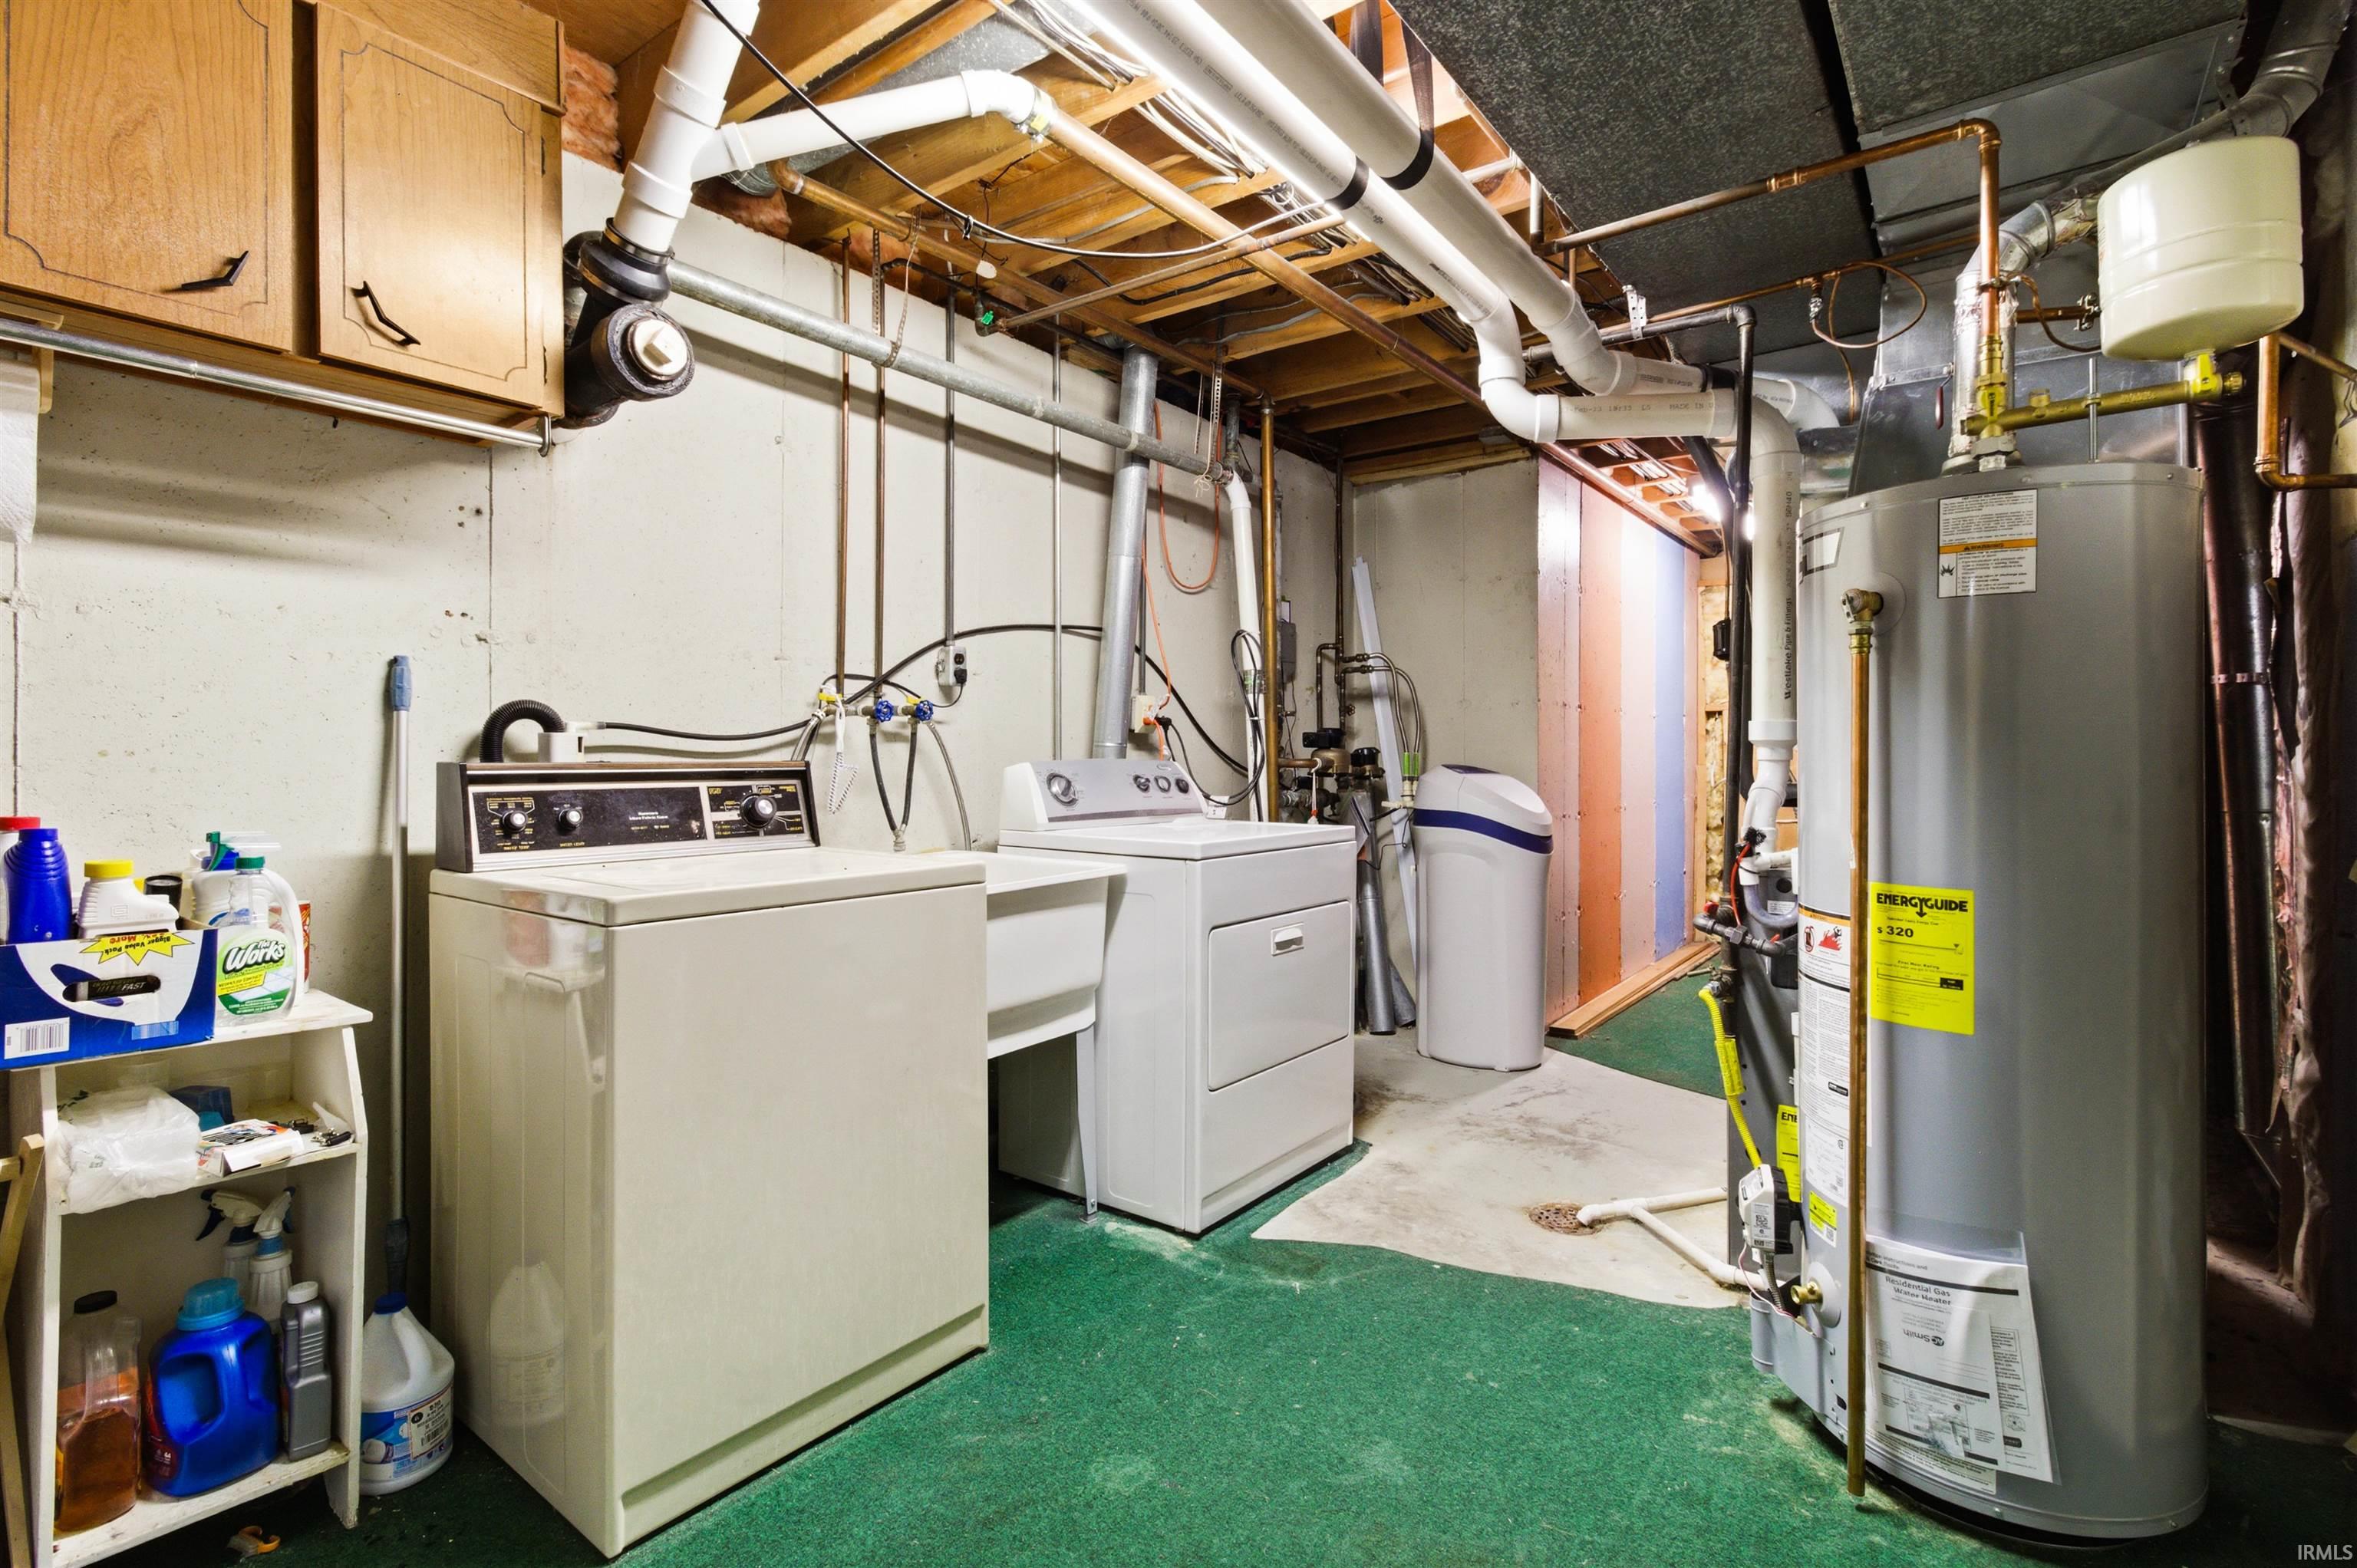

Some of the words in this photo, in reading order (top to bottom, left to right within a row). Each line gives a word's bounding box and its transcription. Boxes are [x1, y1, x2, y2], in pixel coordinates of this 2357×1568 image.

[1784, 652, 1792, 700] Westlake
[1877, 893, 1968, 915] ENERGYGUIDE
[1887, 926, 1914, 937] 320
[110, 935, 137, 944] More
[124, 940, 145, 950] Value
[104, 946, 123, 955] Pack
[223, 940, 285, 973] Works
[121, 982, 146, 991] FAST
[1885, 1276, 1932, 1294] Residential
[1894, 1286, 1920, 1299] Water
[1922, 1294, 1952, 1306] Heater
[1903, 1329, 1930, 1342] Smith
